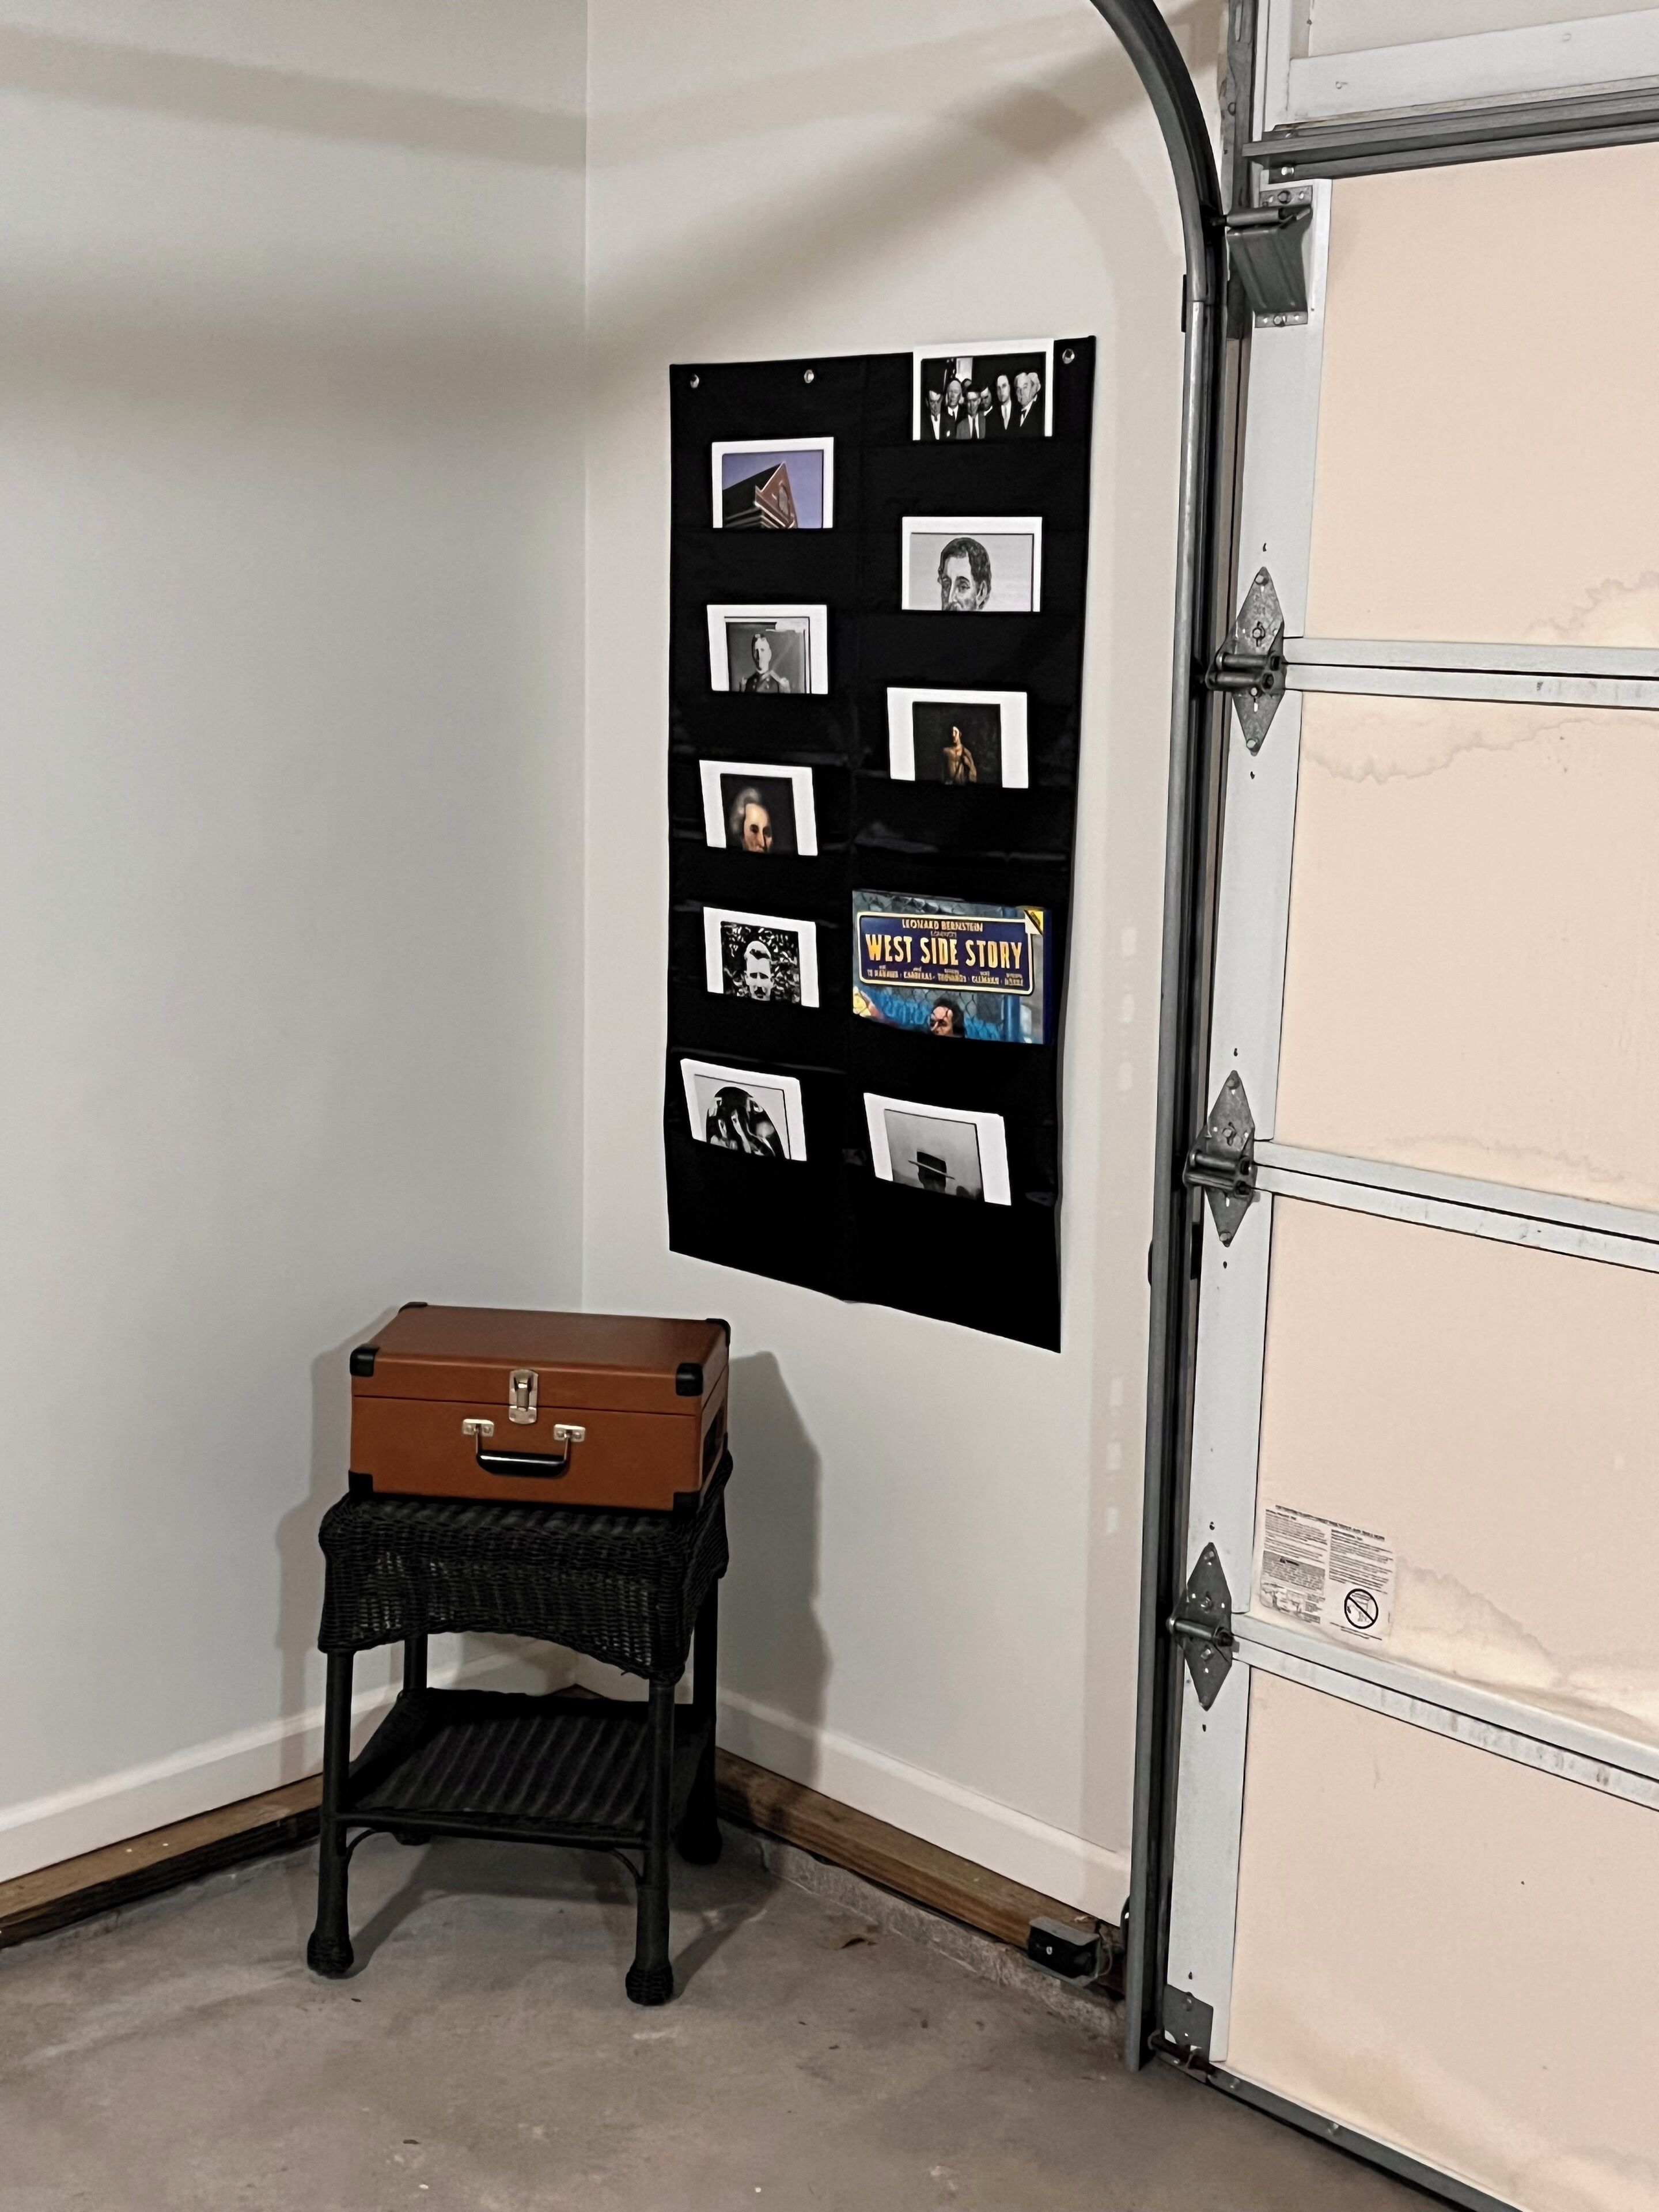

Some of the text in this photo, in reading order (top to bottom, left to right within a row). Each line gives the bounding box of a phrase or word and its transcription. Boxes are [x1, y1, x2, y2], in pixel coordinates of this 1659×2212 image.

[902, 919, 983, 932] LEONARD BERNSTEIN
[865, 934, 1022, 969] WEST SIDE STORY
